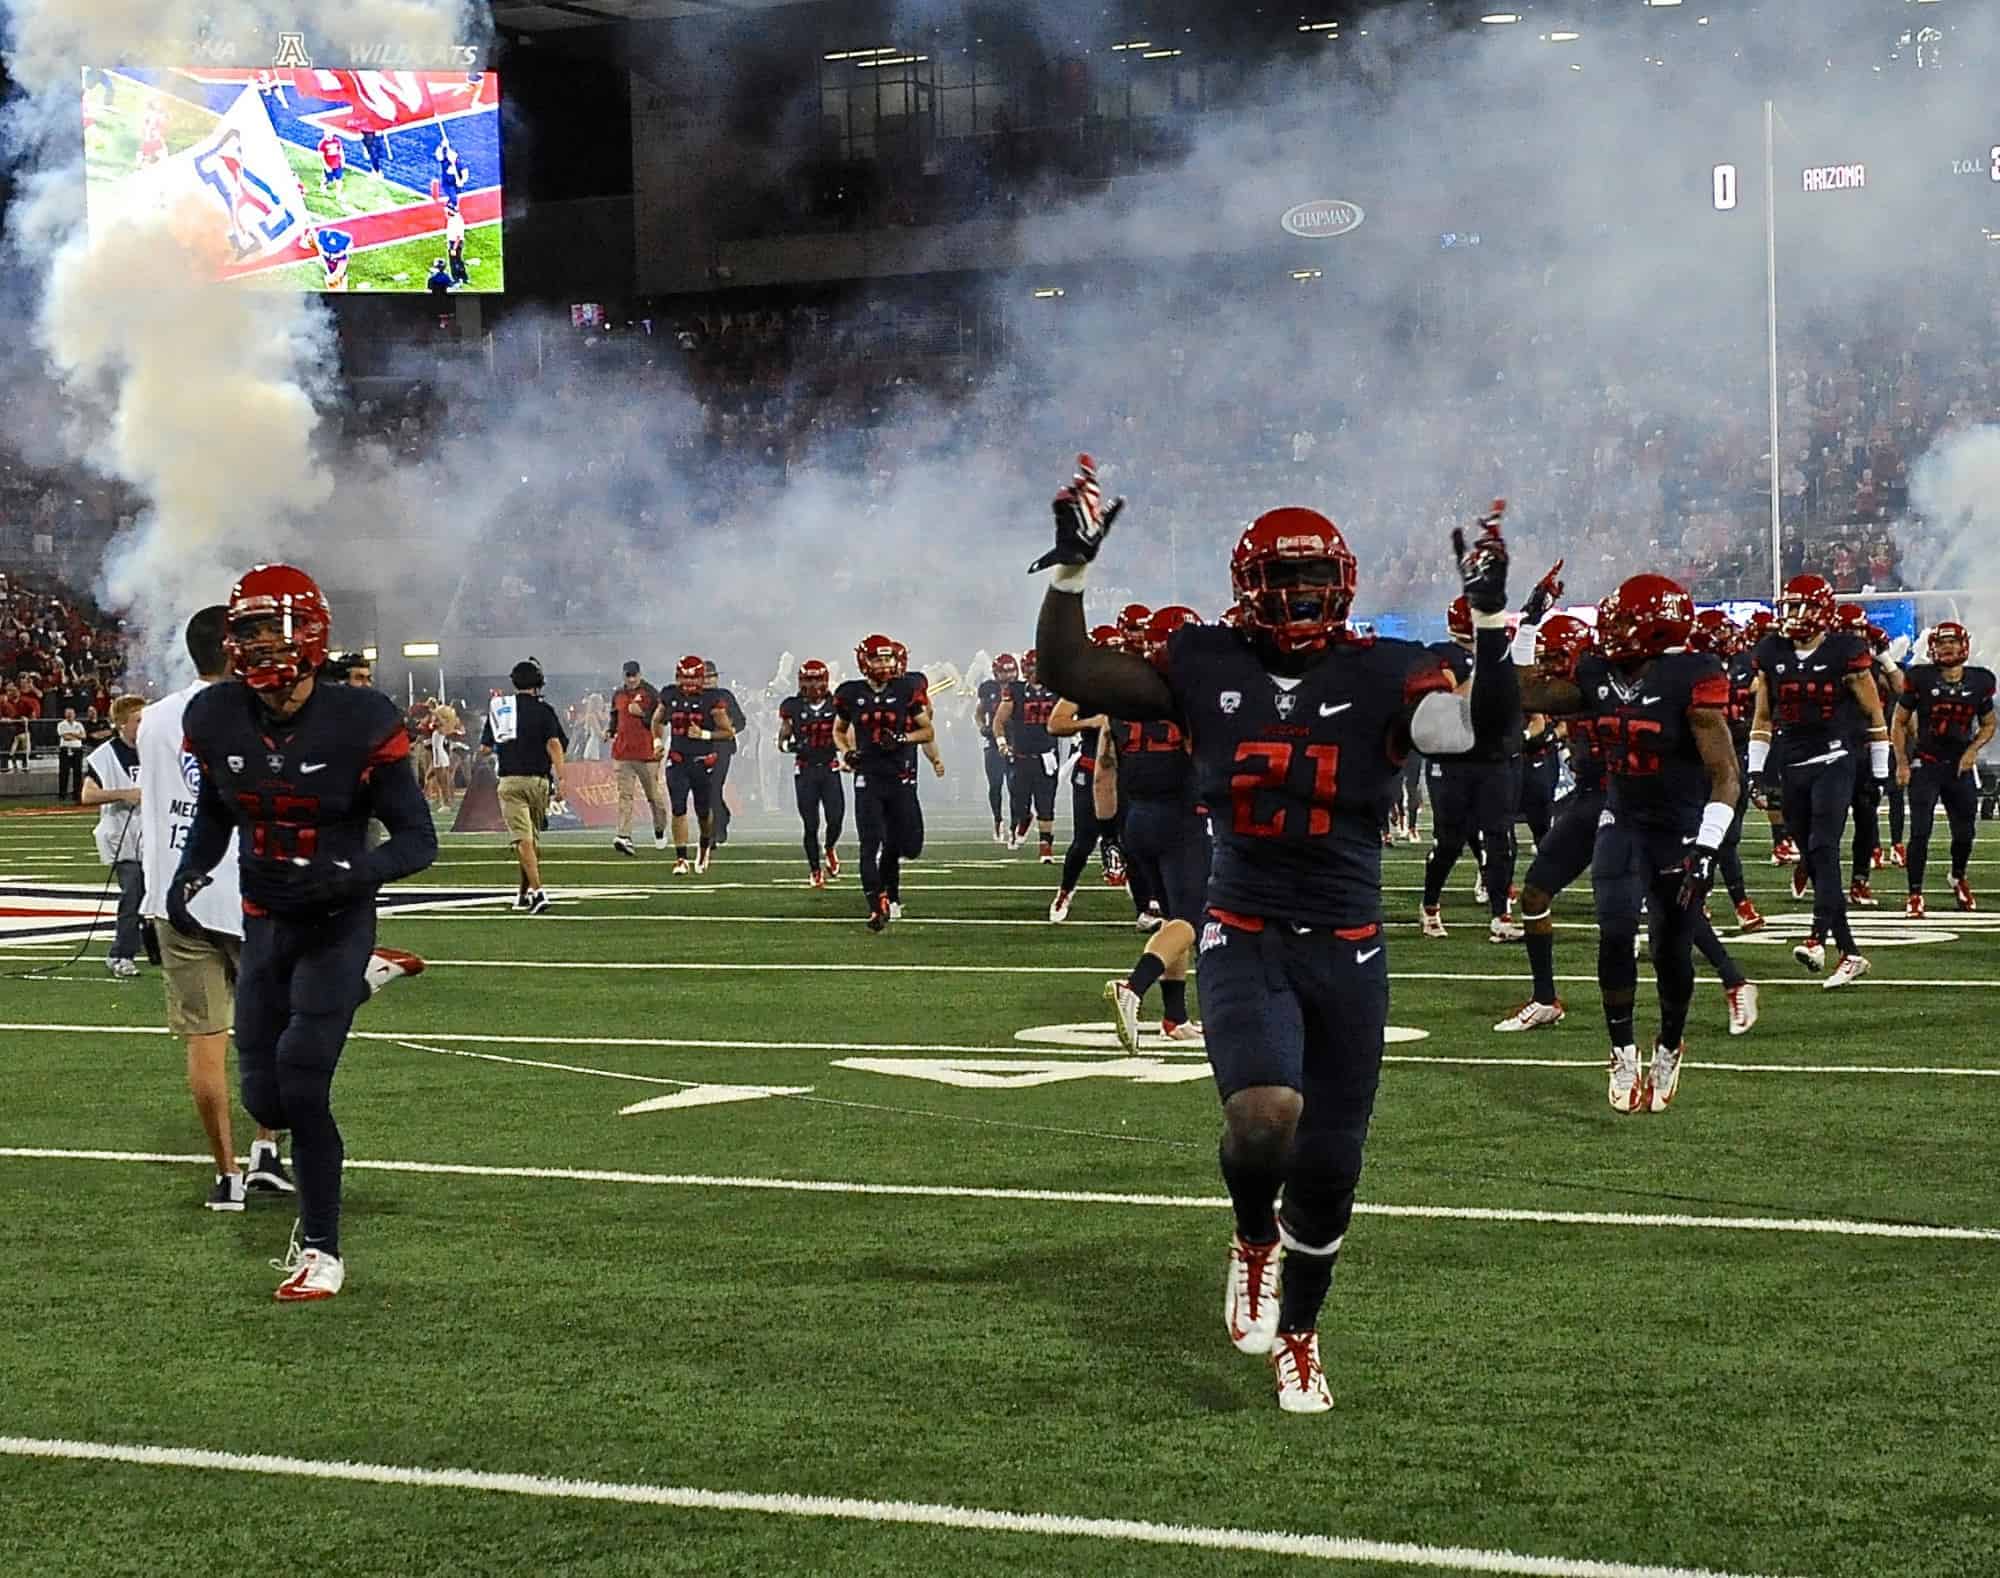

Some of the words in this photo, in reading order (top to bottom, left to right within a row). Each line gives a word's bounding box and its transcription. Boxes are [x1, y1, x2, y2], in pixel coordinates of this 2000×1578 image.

[275, 32, 312, 68] A
[350, 44, 479, 65] WILDATS
[1713, 164, 1737, 210] 0
[1803, 164, 1865, 191] ARIZONA
[1292, 208, 1351, 227] CHAPMAN
[1231, 741, 1340, 837] 21
